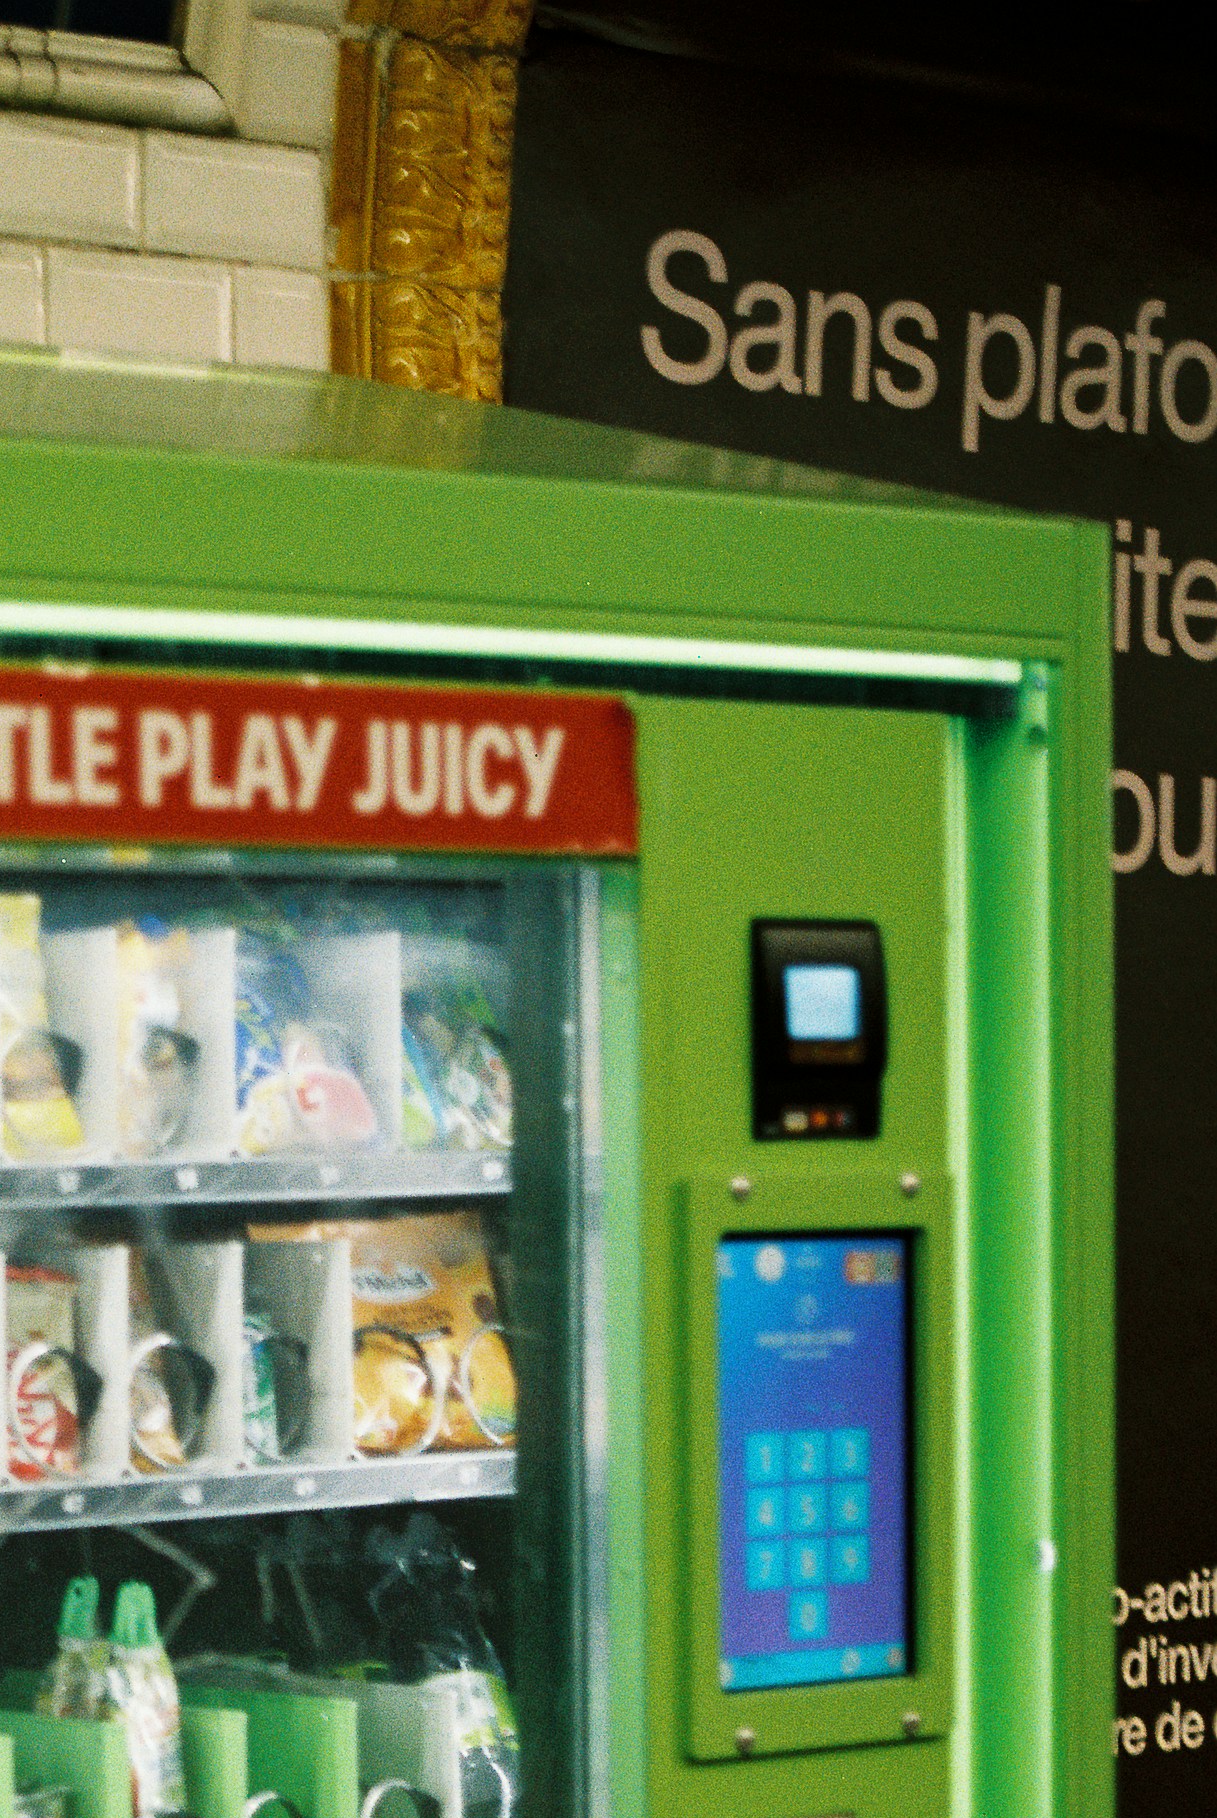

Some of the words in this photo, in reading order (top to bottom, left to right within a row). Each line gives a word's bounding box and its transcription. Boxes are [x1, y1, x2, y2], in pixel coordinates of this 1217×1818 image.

[640, 229, 939, 409] Sans
[961, 284, 1217, 452] plafo
[1115, 518, 1217, 662] ite
[137, 708, 337, 814] PLAY
[351, 717, 566, 819] JUICY
[1155, 1699, 1206, 1752] de
